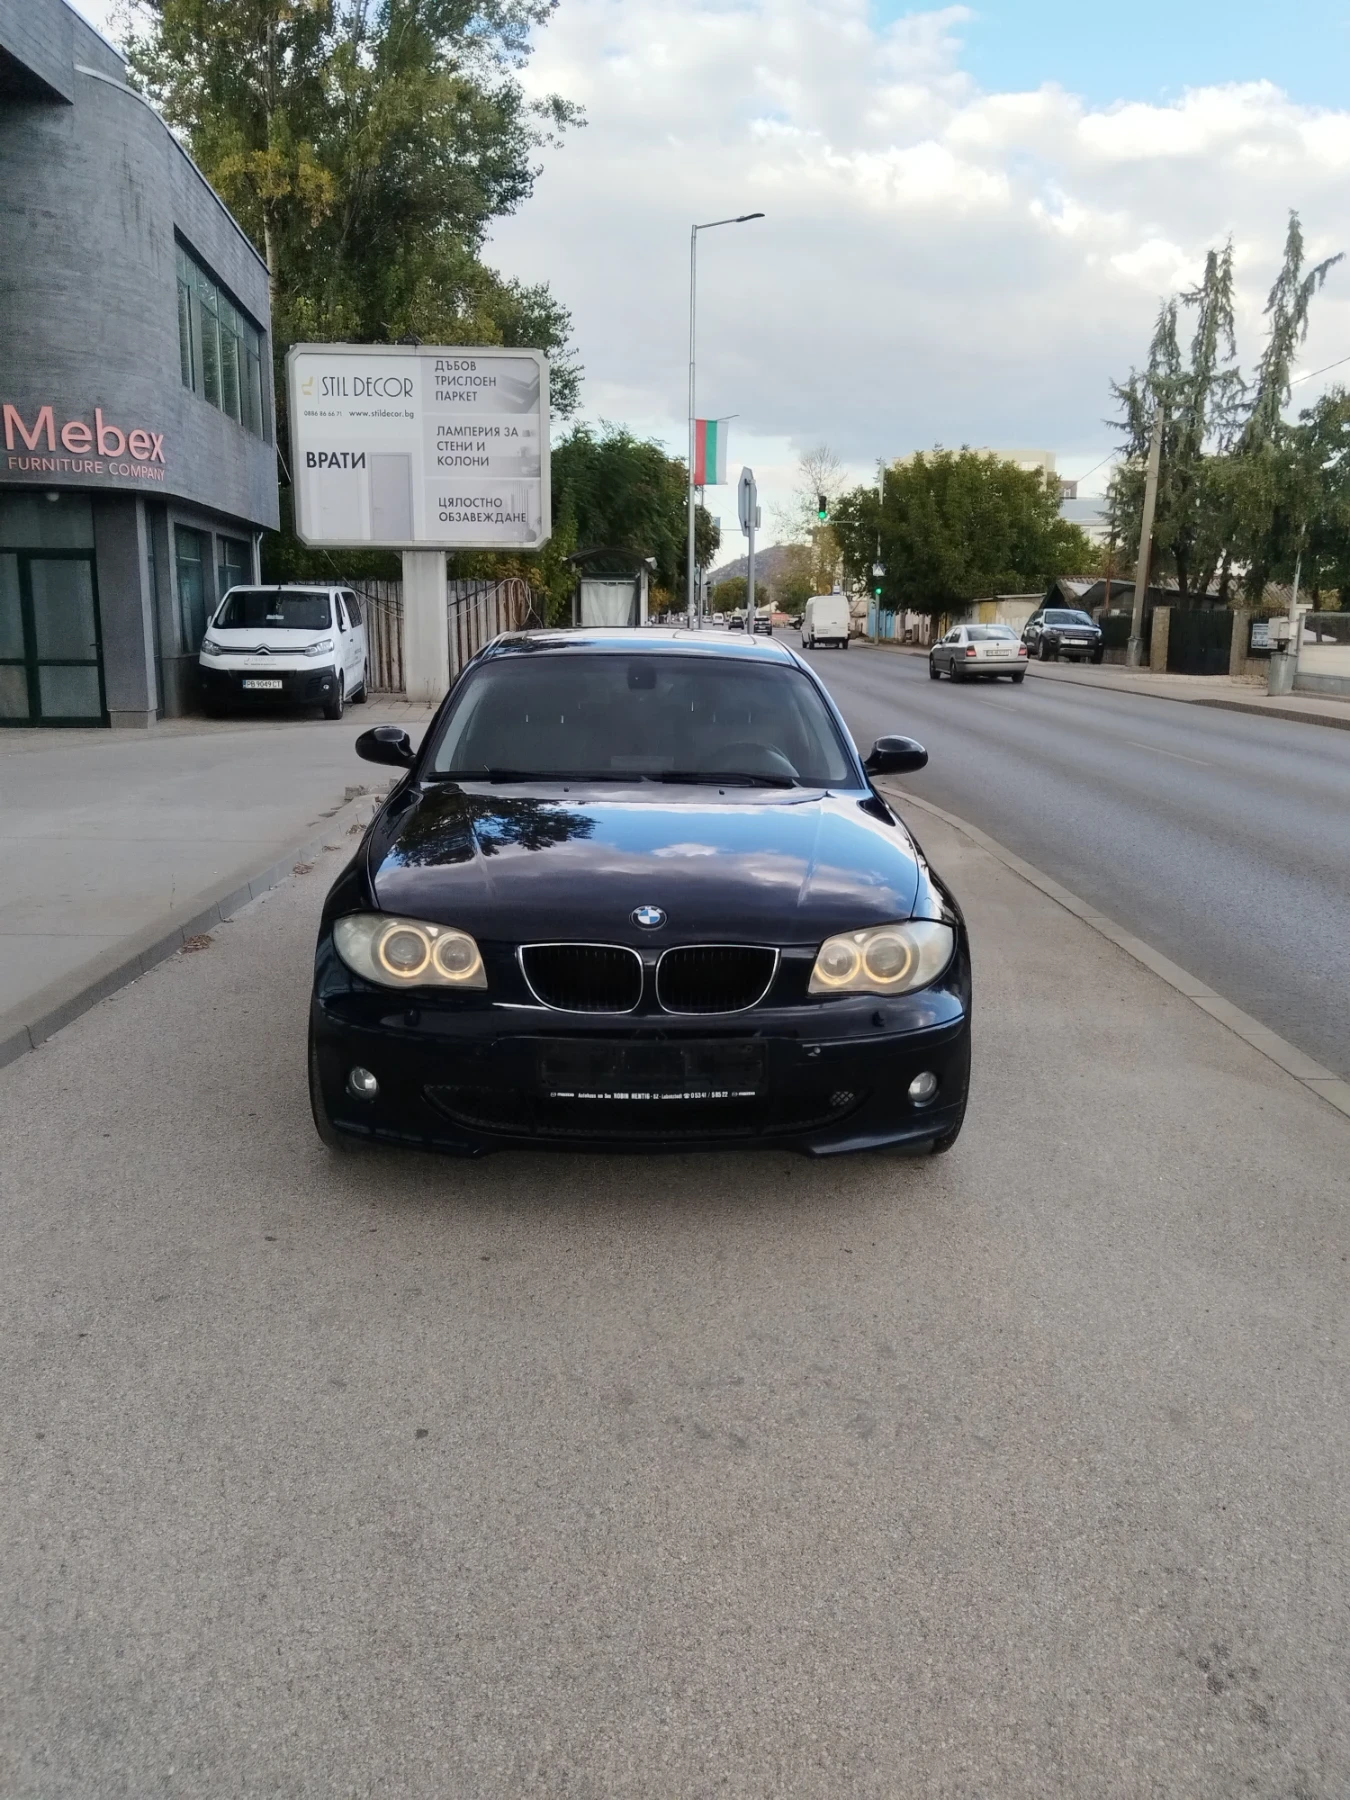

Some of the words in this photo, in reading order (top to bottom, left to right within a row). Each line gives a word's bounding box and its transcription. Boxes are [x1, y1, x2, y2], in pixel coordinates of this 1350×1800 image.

[435, 360, 477, 372] ДЪБОВ
[321, 376, 349, 397] STIL
[353, 376, 414, 398] DECOR
[434, 375, 497, 387] ТРИСЛОЕН
[435, 390, 478, 402] ПАРКЕТ
[348, 409, 415, 420] www.stildecor.bg
[2, 403, 166, 464] Mebex
[436, 425, 501, 437] ЛАМПЕРИЯ
[503, 426, 519, 438] ЗА
[436, 440, 473, 452] СТЕНИ
[476, 441, 486, 452] И
[305, 451, 366, 469] ВРАТИ
[437, 455, 490, 467] КОЛОНИ
[7, 456, 104, 474] FURNITURE
[108, 462, 166, 482] COMPANY
[438, 497, 503, 509] ЦЯЛОСТНО
[438, 511, 527, 524] ОБЗАВЕЖДАНЕ
